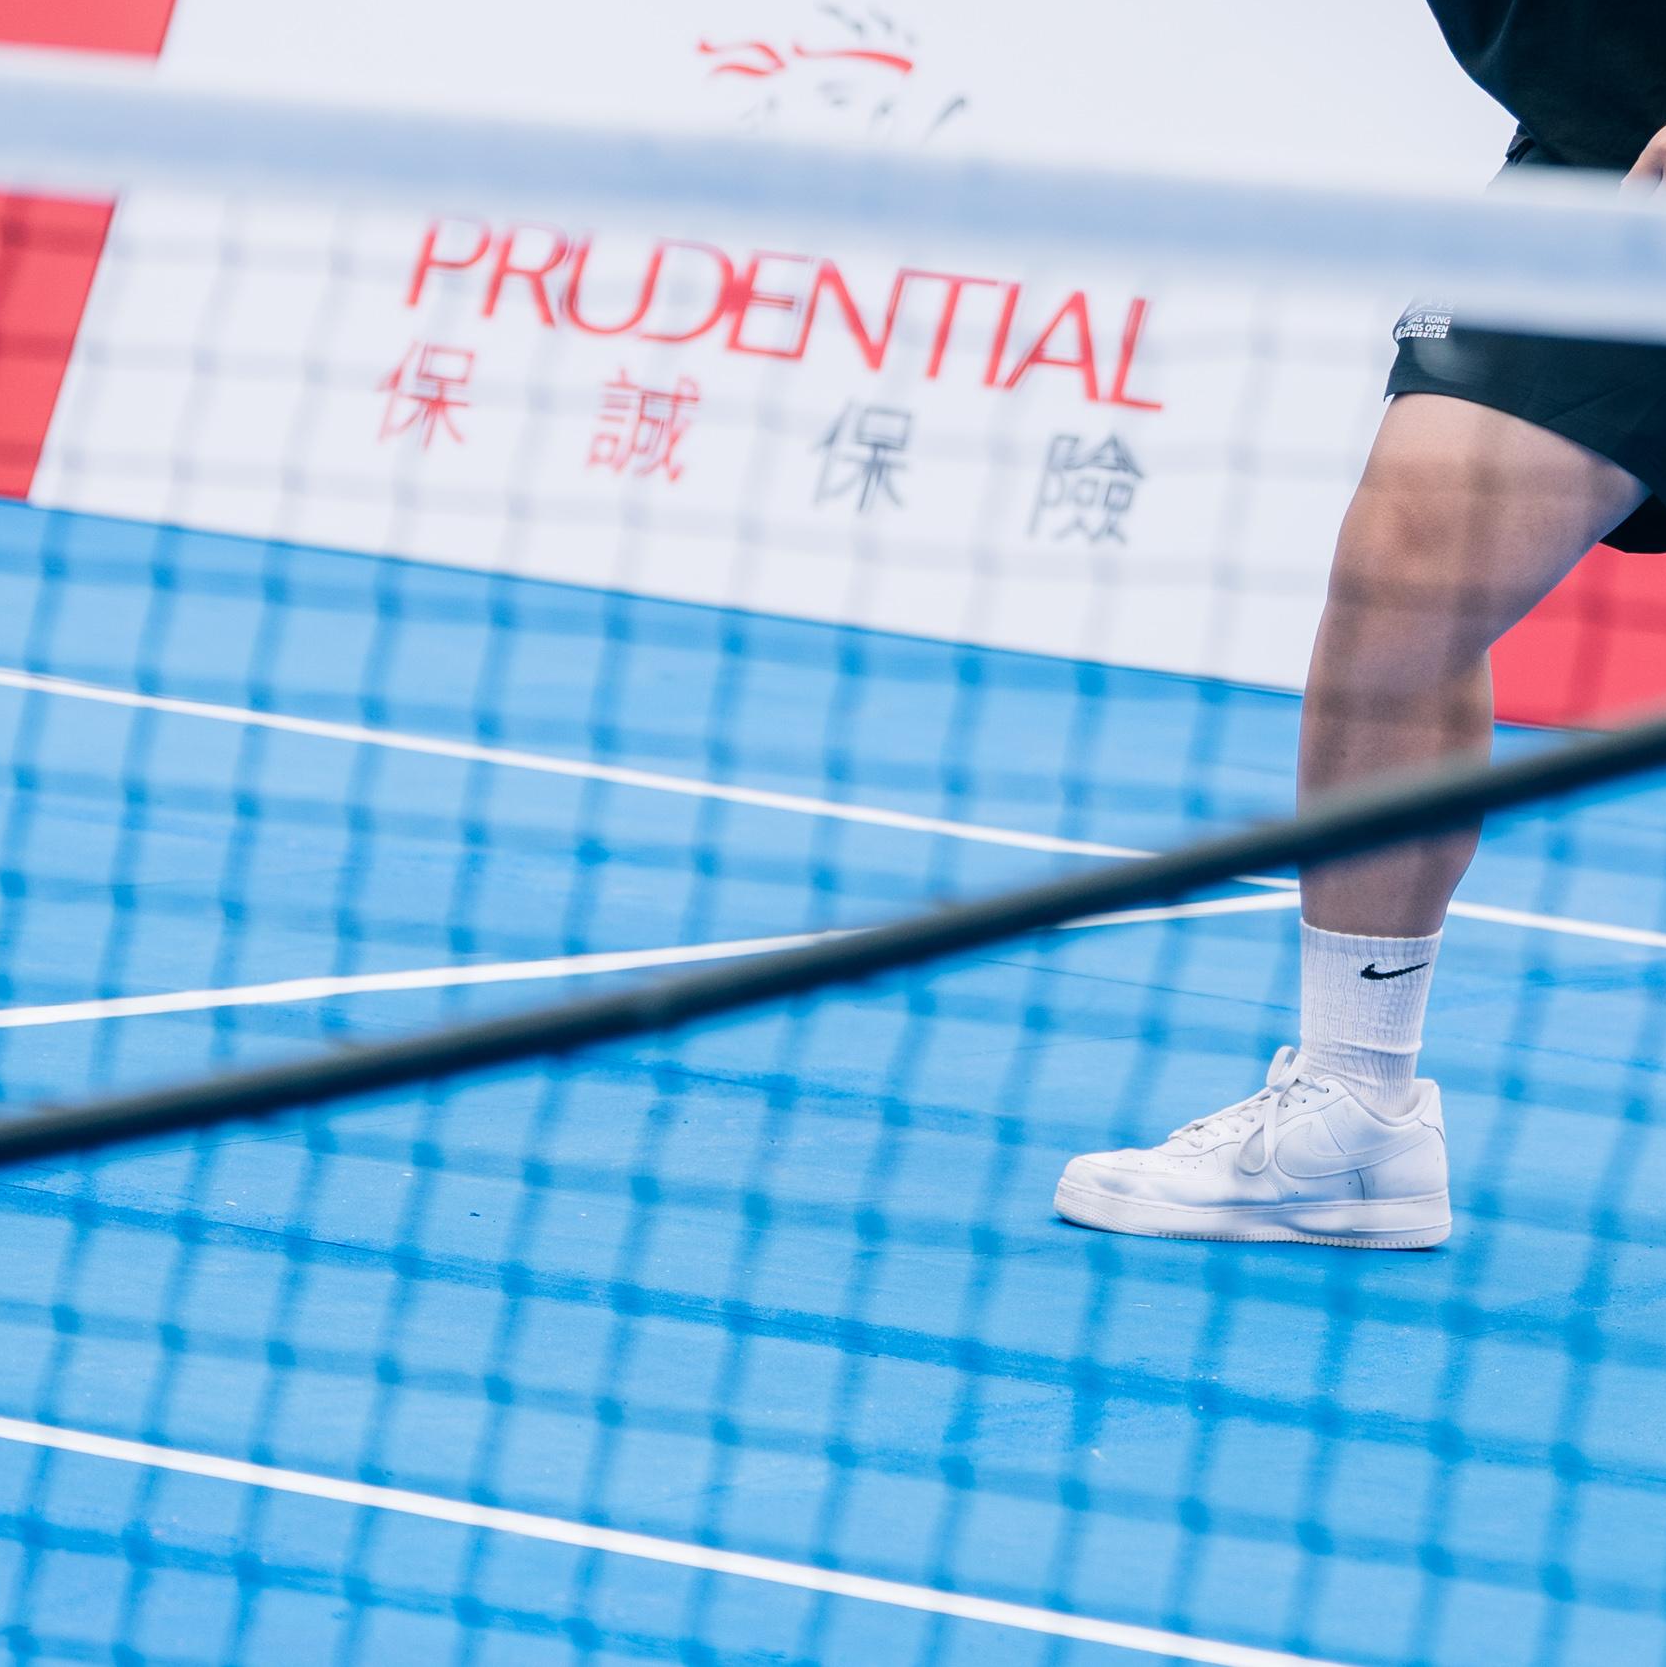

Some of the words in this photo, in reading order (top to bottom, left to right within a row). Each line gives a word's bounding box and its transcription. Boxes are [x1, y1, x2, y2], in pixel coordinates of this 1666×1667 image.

[404, 214, 1165, 414] PRUDENTIAL
[1424, 315, 1451, 325] KONG
[1424, 324, 1449, 332] OPEN
[375, 337, 1145, 547] 保誠保險
